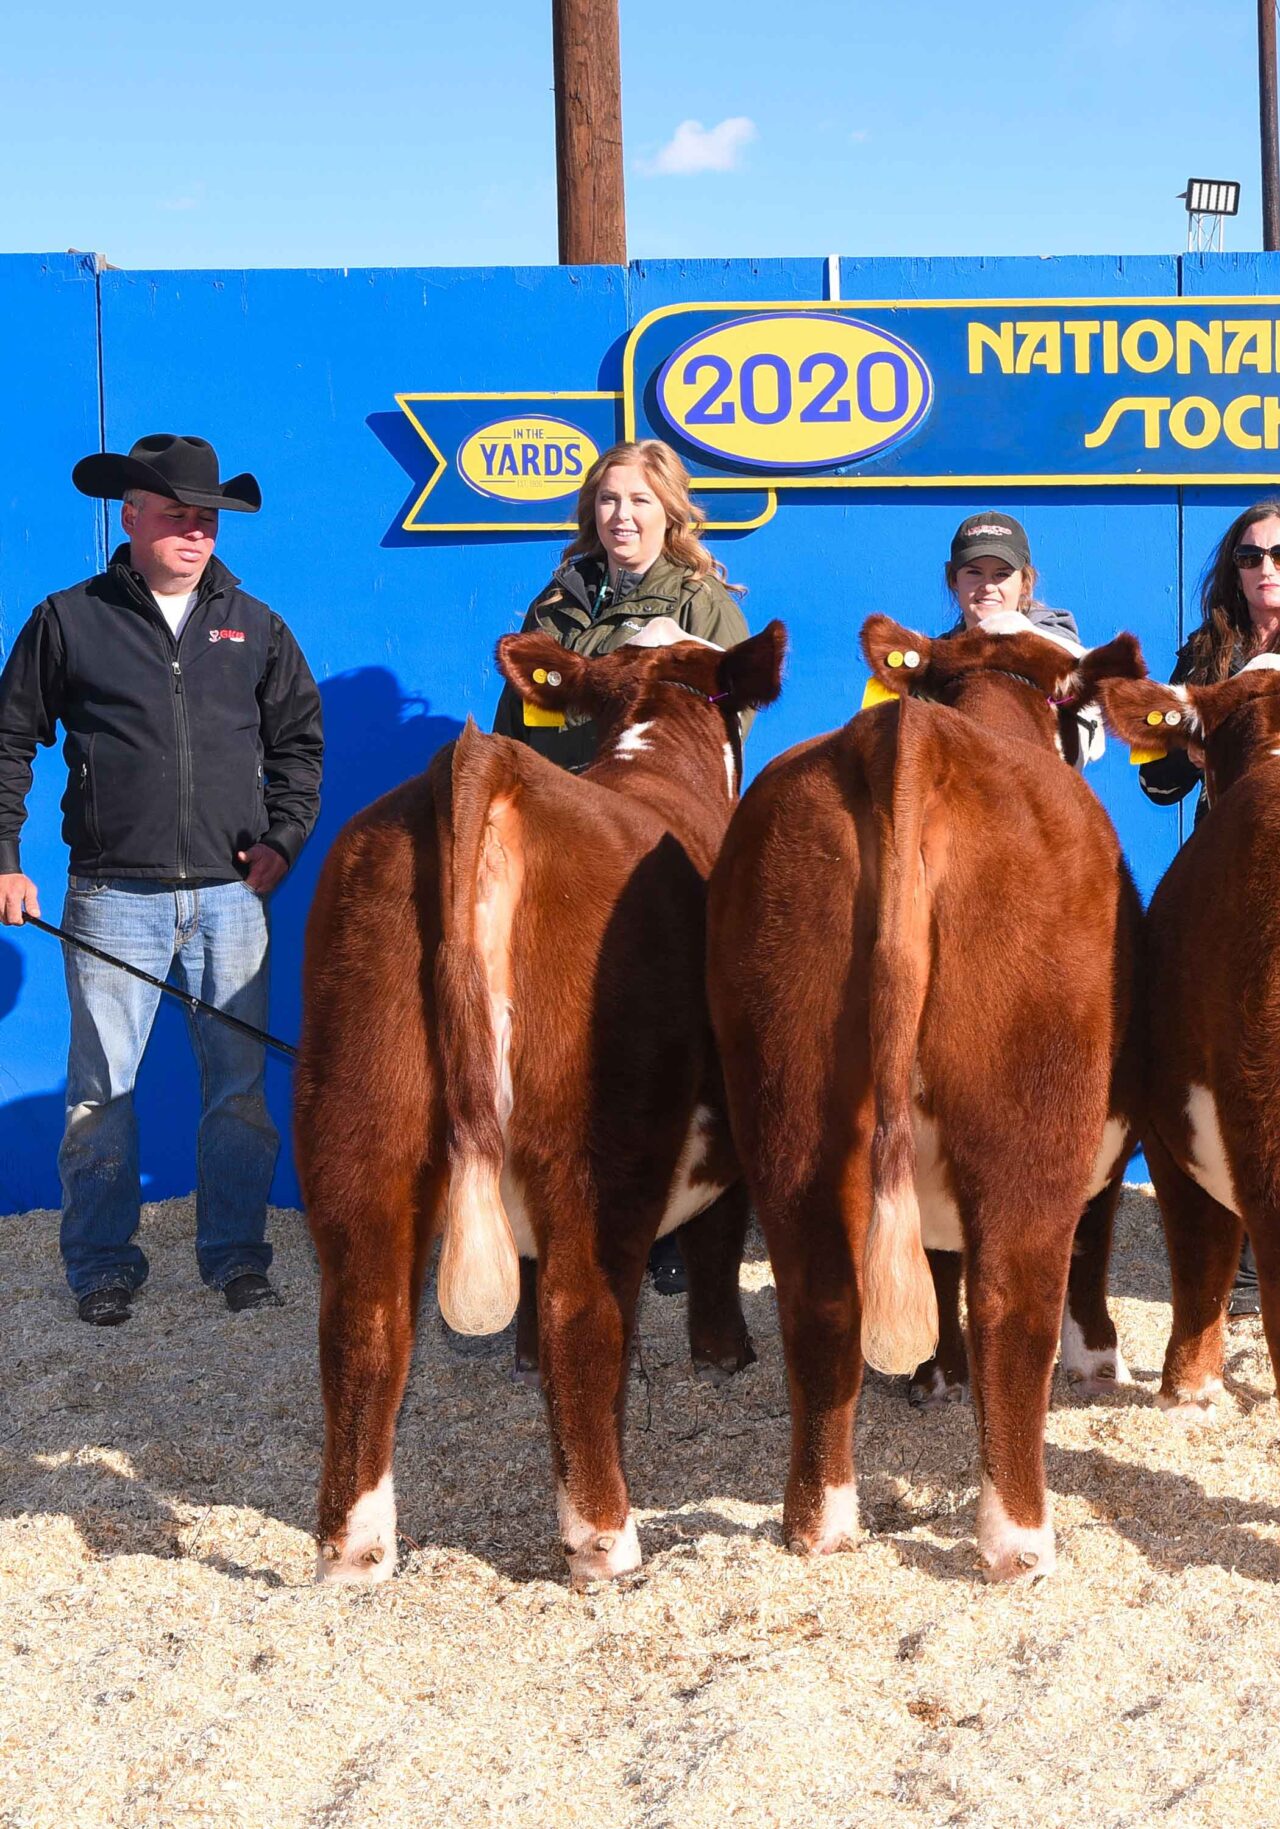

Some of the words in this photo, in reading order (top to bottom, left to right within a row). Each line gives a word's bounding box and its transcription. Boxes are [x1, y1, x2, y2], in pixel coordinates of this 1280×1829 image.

[683, 352, 909, 425] 2020
[513, 428, 523, 439] IN
[526, 428, 544, 439] THE
[479, 443, 583, 476] YARDS
